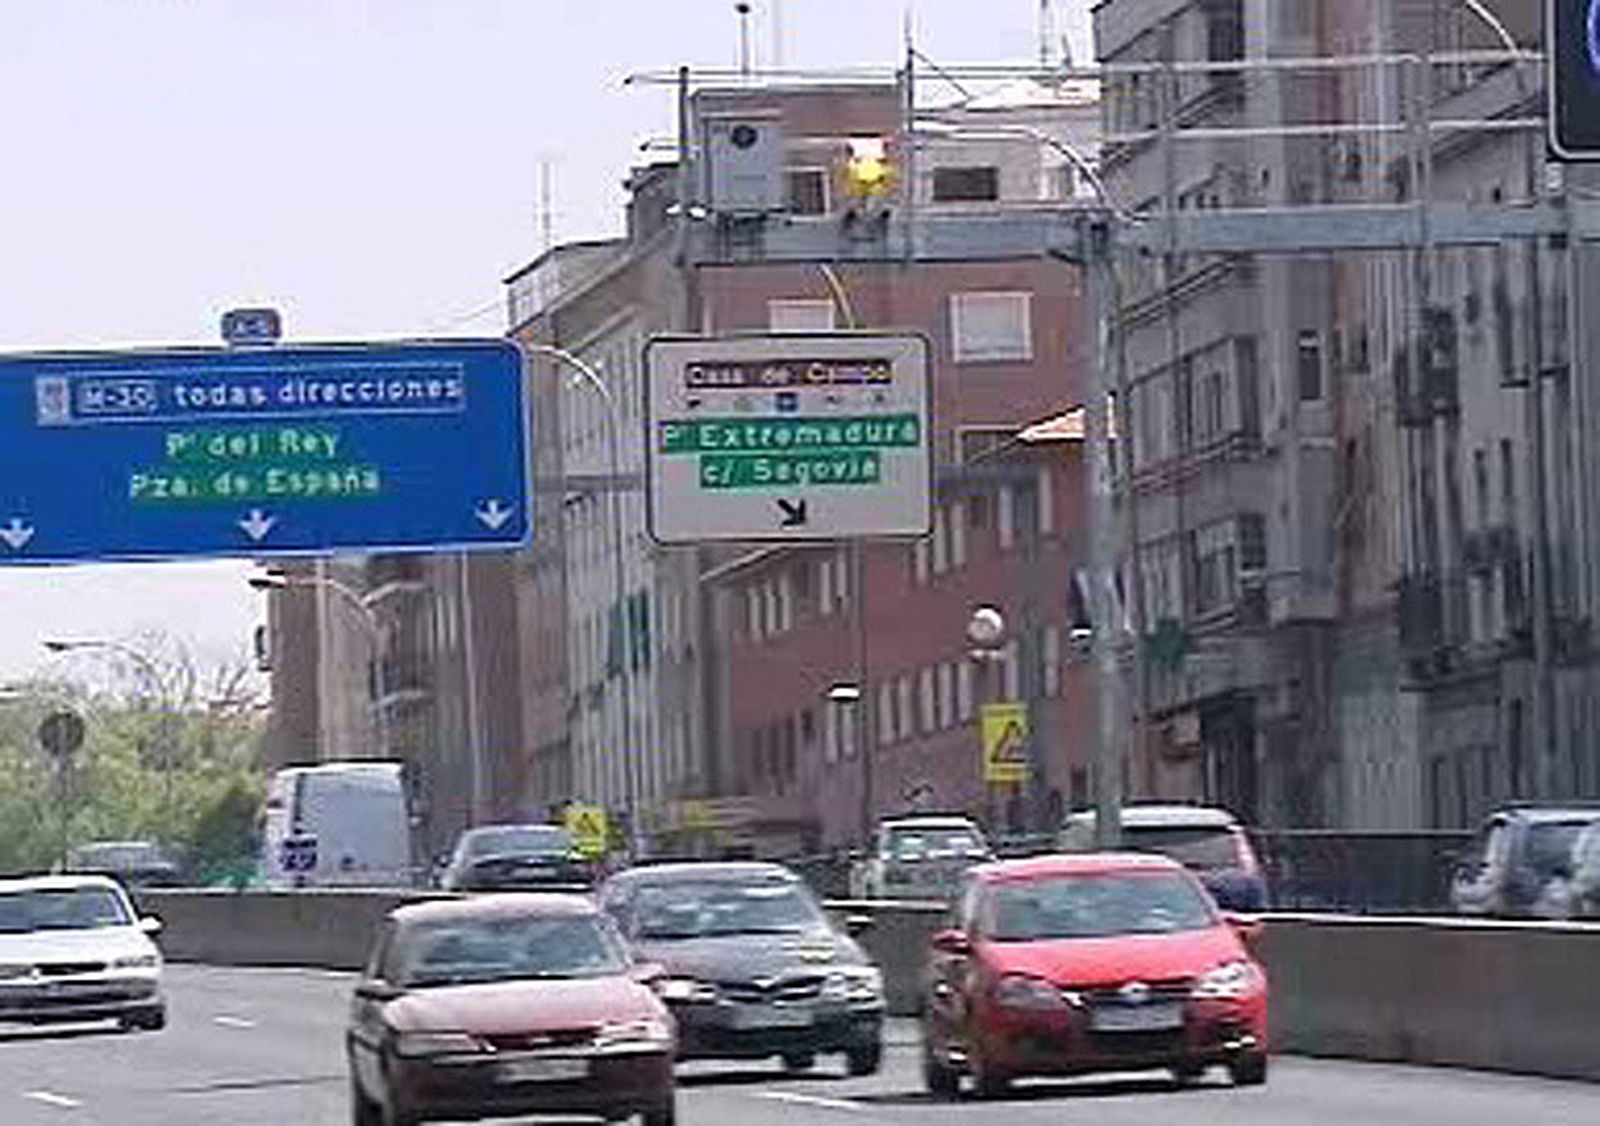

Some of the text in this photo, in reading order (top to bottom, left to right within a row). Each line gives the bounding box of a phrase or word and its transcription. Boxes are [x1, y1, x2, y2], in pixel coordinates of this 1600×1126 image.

[174, 383, 266, 407] todas
[278, 377, 463, 403] direcciones
[207, 432, 260, 456] del
[278, 428, 339, 457] Rey
[699, 418, 917, 448] Extremadura
[213, 470, 249, 496] de
[266, 465, 380, 496] España
[752, 454, 878, 485] Segovia
